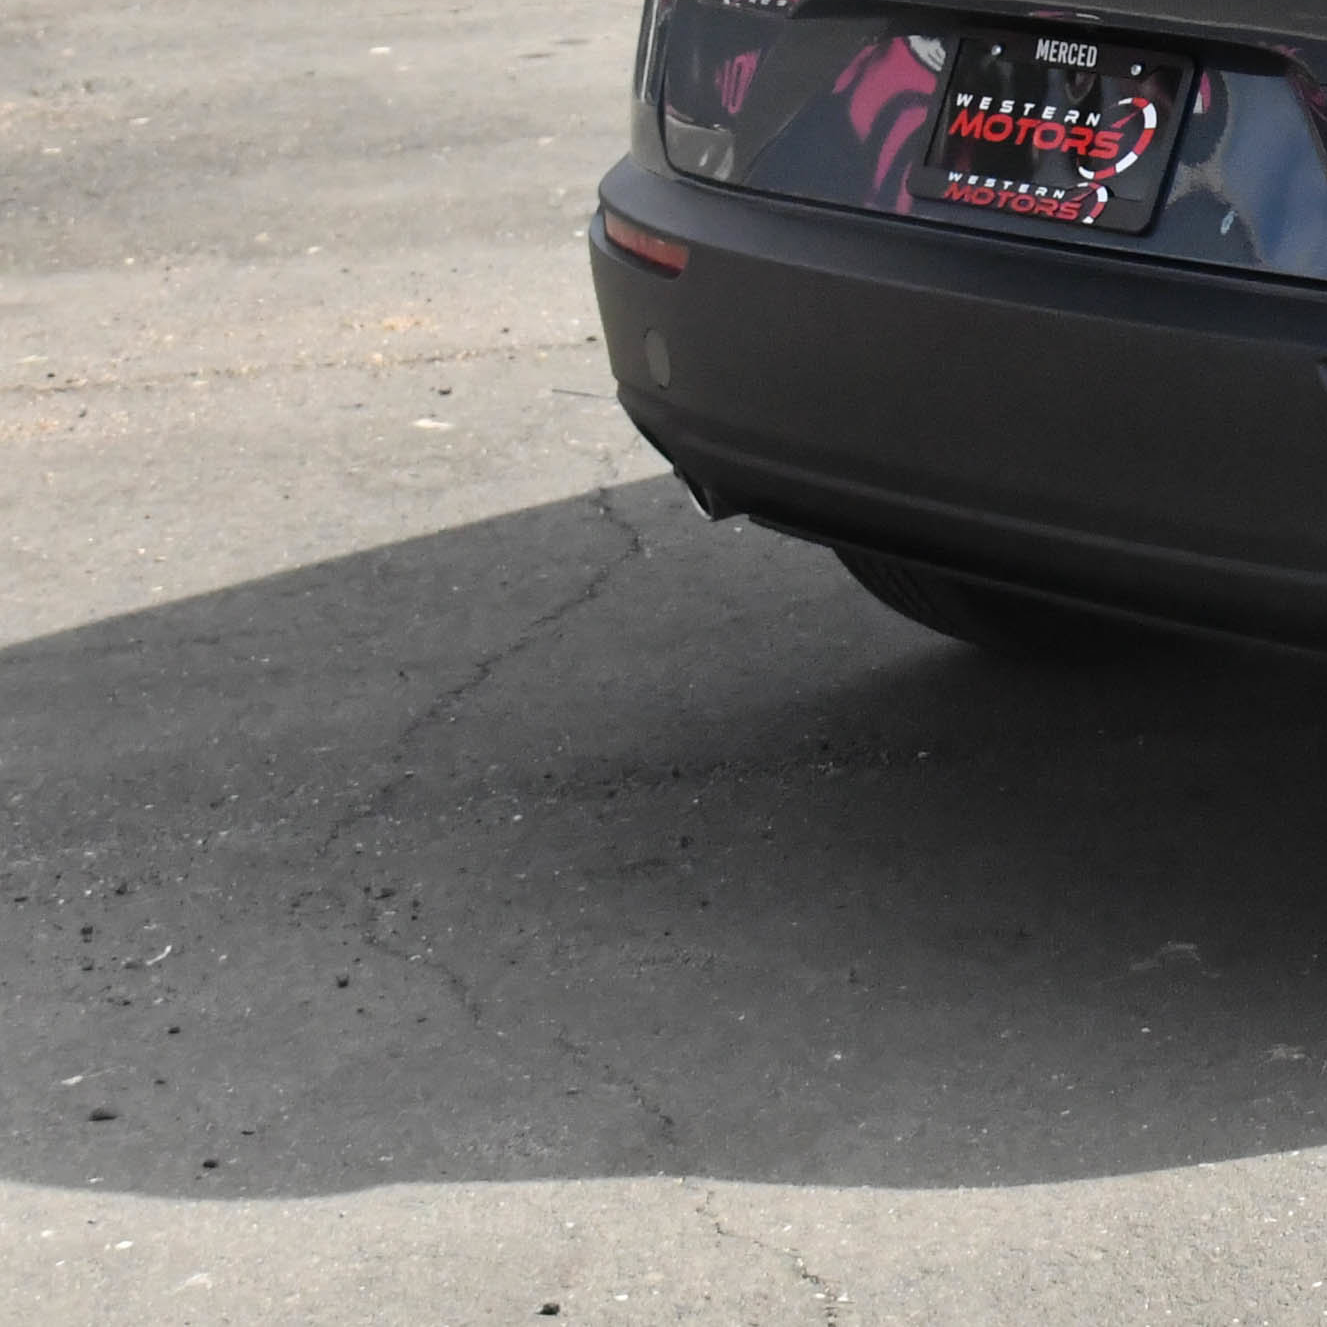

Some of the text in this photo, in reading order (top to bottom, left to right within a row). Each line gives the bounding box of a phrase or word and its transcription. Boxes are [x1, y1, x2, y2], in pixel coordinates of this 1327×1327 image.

[1035, 38, 1098, 67] MERCED
[956, 93, 1101, 127] WESTERN
[949, 108, 1124, 159] MOTORS
[943, 181, 1081, 221] MOTORS
[948, 172, 1066, 199] WESTERN
